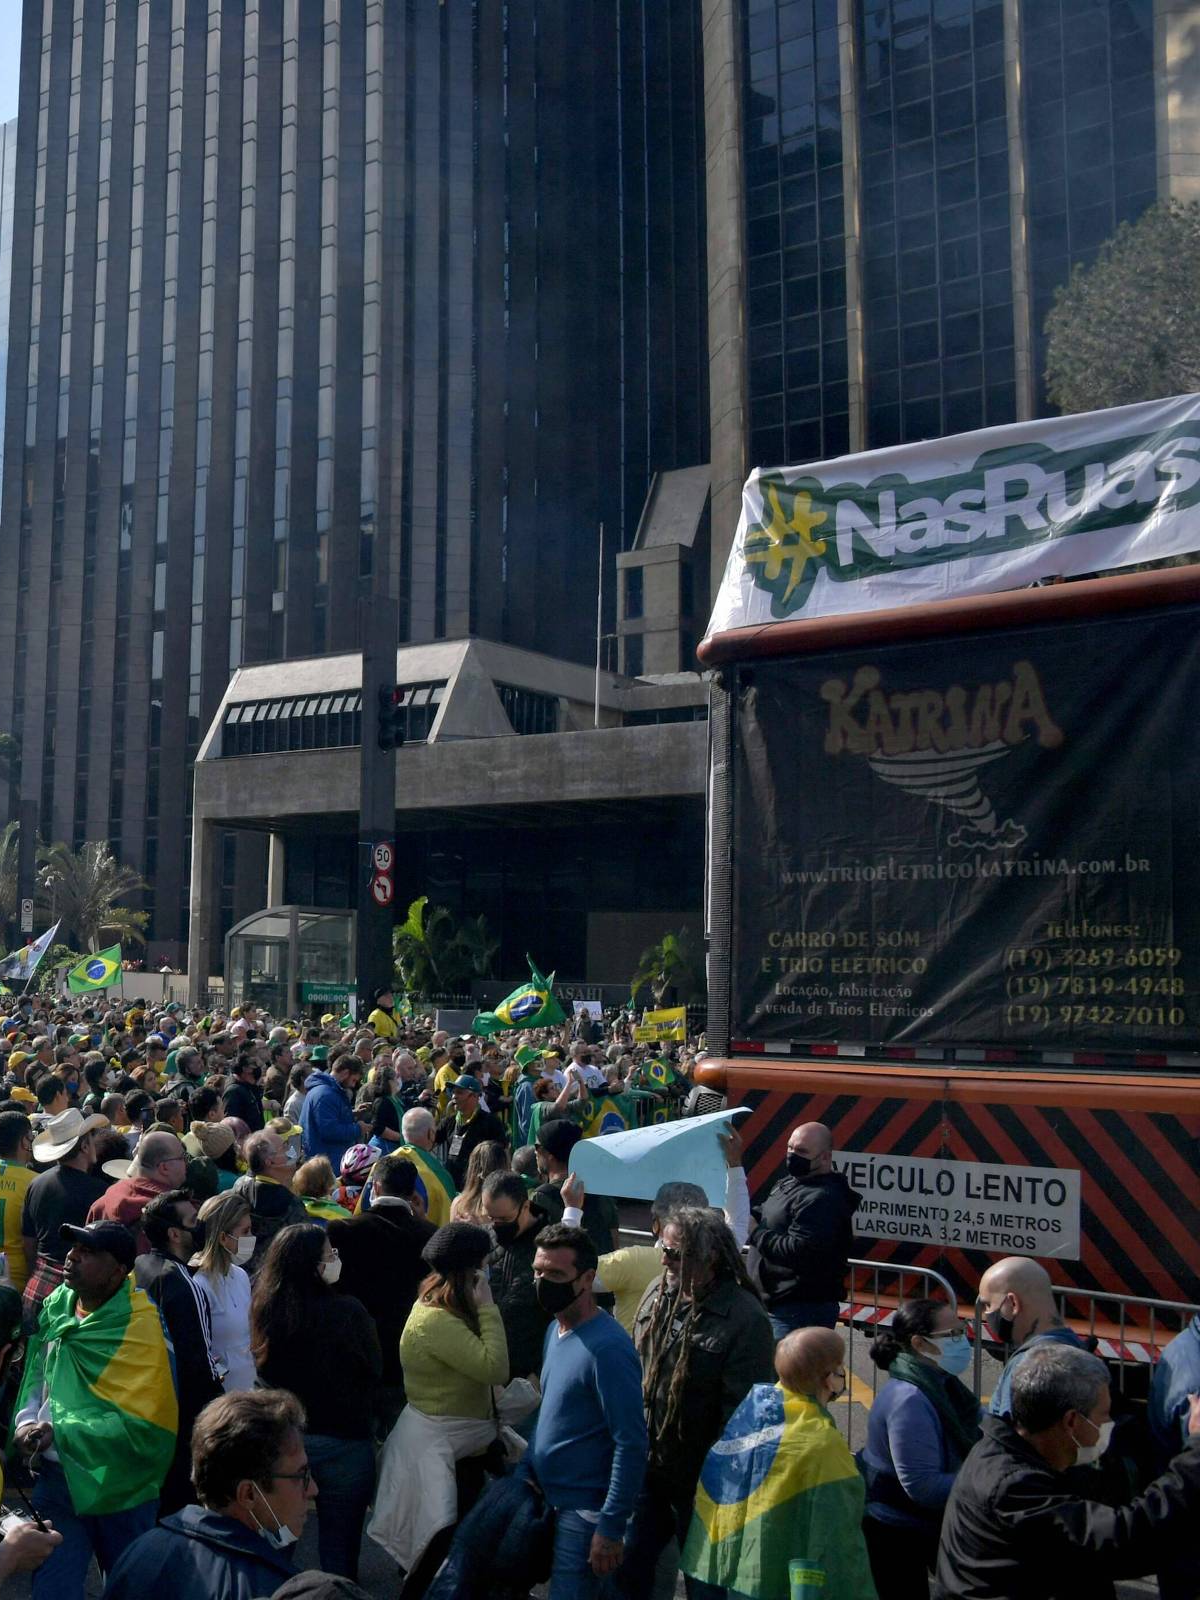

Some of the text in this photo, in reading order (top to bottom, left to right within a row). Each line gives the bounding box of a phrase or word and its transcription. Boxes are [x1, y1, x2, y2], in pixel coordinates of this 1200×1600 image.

[820, 660, 1064, 756] KATRINA
[377, 849, 390, 862] 50
[768, 931, 920, 948] CARRO DE SOM
[761, 957, 772, 973] E
[778, 957, 823, 974] TRIO
[1008, 948, 1052, 972] (19)
[1006, 976, 1185, 1000] (19) 7819-4948
[1007, 1005, 1185, 1028] (19) 9742-7010
[965, 1172, 1066, 1207] LENTO
[856, 1200, 1061, 1233] MPRIMENTO 24,5 METROS
[855, 1218, 933, 1238] LARGURA
[966, 1230, 1036, 1250] METROS
